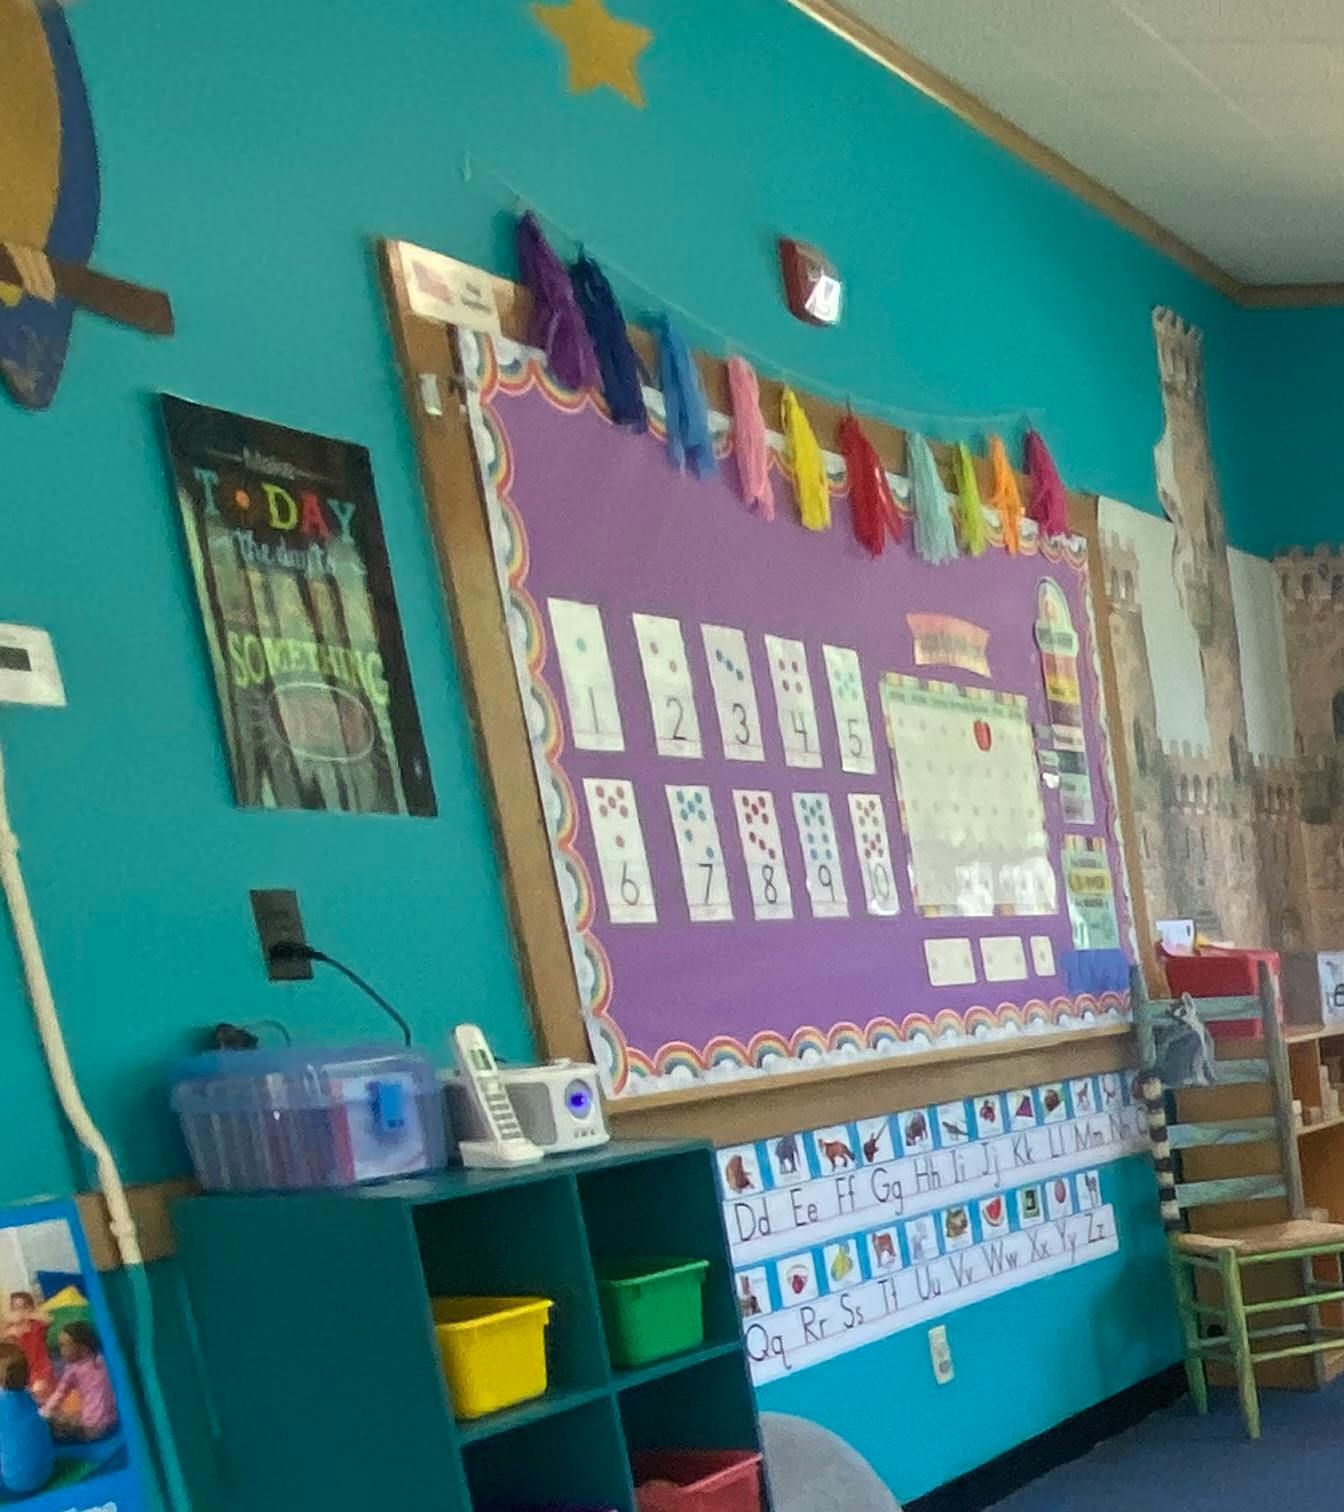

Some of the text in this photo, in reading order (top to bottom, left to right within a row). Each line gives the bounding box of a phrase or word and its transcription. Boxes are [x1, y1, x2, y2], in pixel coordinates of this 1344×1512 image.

[587, 685, 864, 759] 1 2 3 4 5
[620, 860, 891, 906] 6 7 8 9 10
[734, 1197, 771, 1242] Dd
[790, 1188, 818, 1227] Ee
[835, 1174, 856, 1216] Ff
[871, 1167, 904, 1216] Gg
[913, 1157, 942, 1193] Hh
[1012, 1131, 1034, 1166] Kk
[746, 1212, 1106, 1371] Qq Rr Ss Tt Uu Vv Ww Xx Yy Zz
